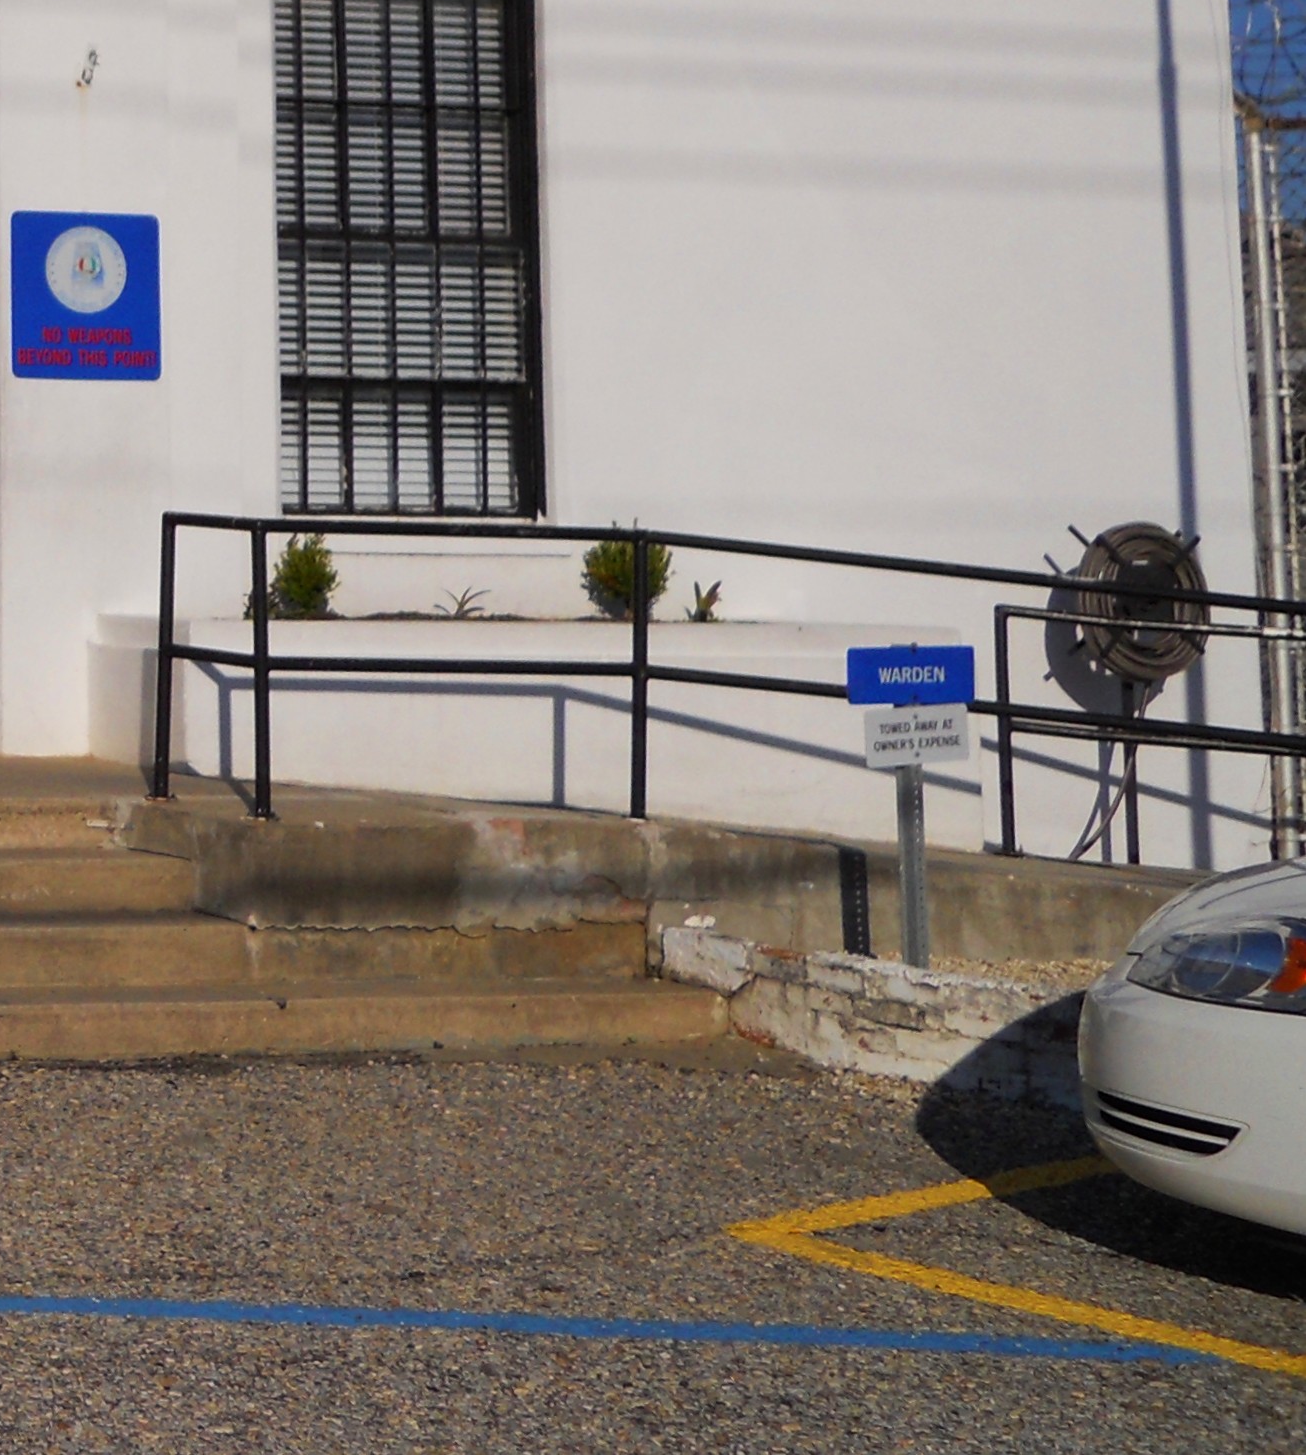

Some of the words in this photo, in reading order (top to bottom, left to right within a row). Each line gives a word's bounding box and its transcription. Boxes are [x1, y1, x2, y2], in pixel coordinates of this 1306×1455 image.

[42, 327, 62, 344] NO
[68, 327, 132, 346] WEAPONS
[18, 348, 72, 366] BEYOND
[79, 350, 108, 367] THIS
[878, 666, 946, 684] WARDEN
[879, 723, 911, 734] TOWED
[914, 720, 938, 731] AWAY
[943, 719, 954, 729] AT
[873, 738, 915, 752] OWNER'S
[919, 735, 961, 749] EXPENSE
